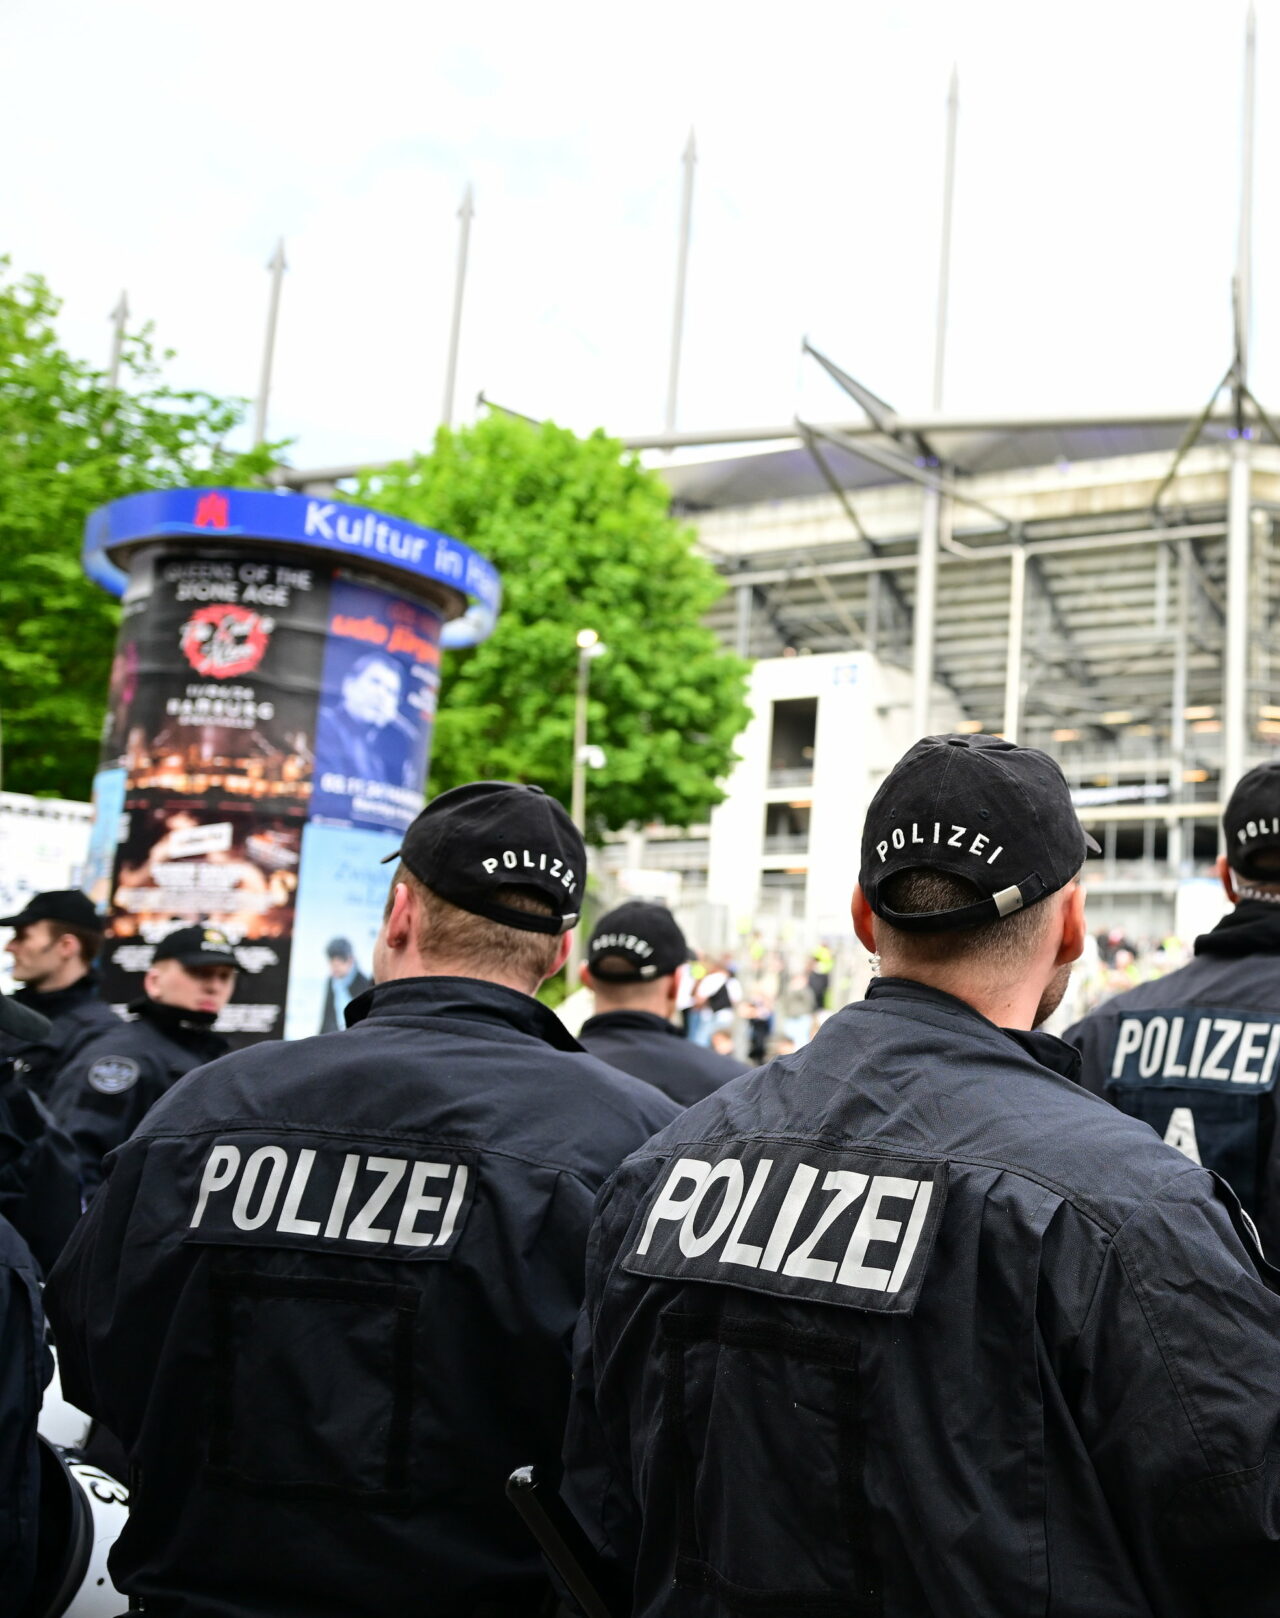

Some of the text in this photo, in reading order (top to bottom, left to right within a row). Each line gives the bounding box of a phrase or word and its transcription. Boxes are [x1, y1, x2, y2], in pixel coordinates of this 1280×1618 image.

[304, 501, 429, 563] Kultur
[434, 538, 464, 579] in
[176, 579, 290, 607] STONE AGE
[238, 562, 271, 584] OF
[276, 565, 313, 591] THE
[876, 822, 1003, 865] POLIZEI
[482, 849, 577, 894] POLIZEI
[592, 932, 655, 959] POLIZEI
[189, 1144, 469, 1247] POLIZEI
[636, 1158, 934, 1293] POLIZEI
